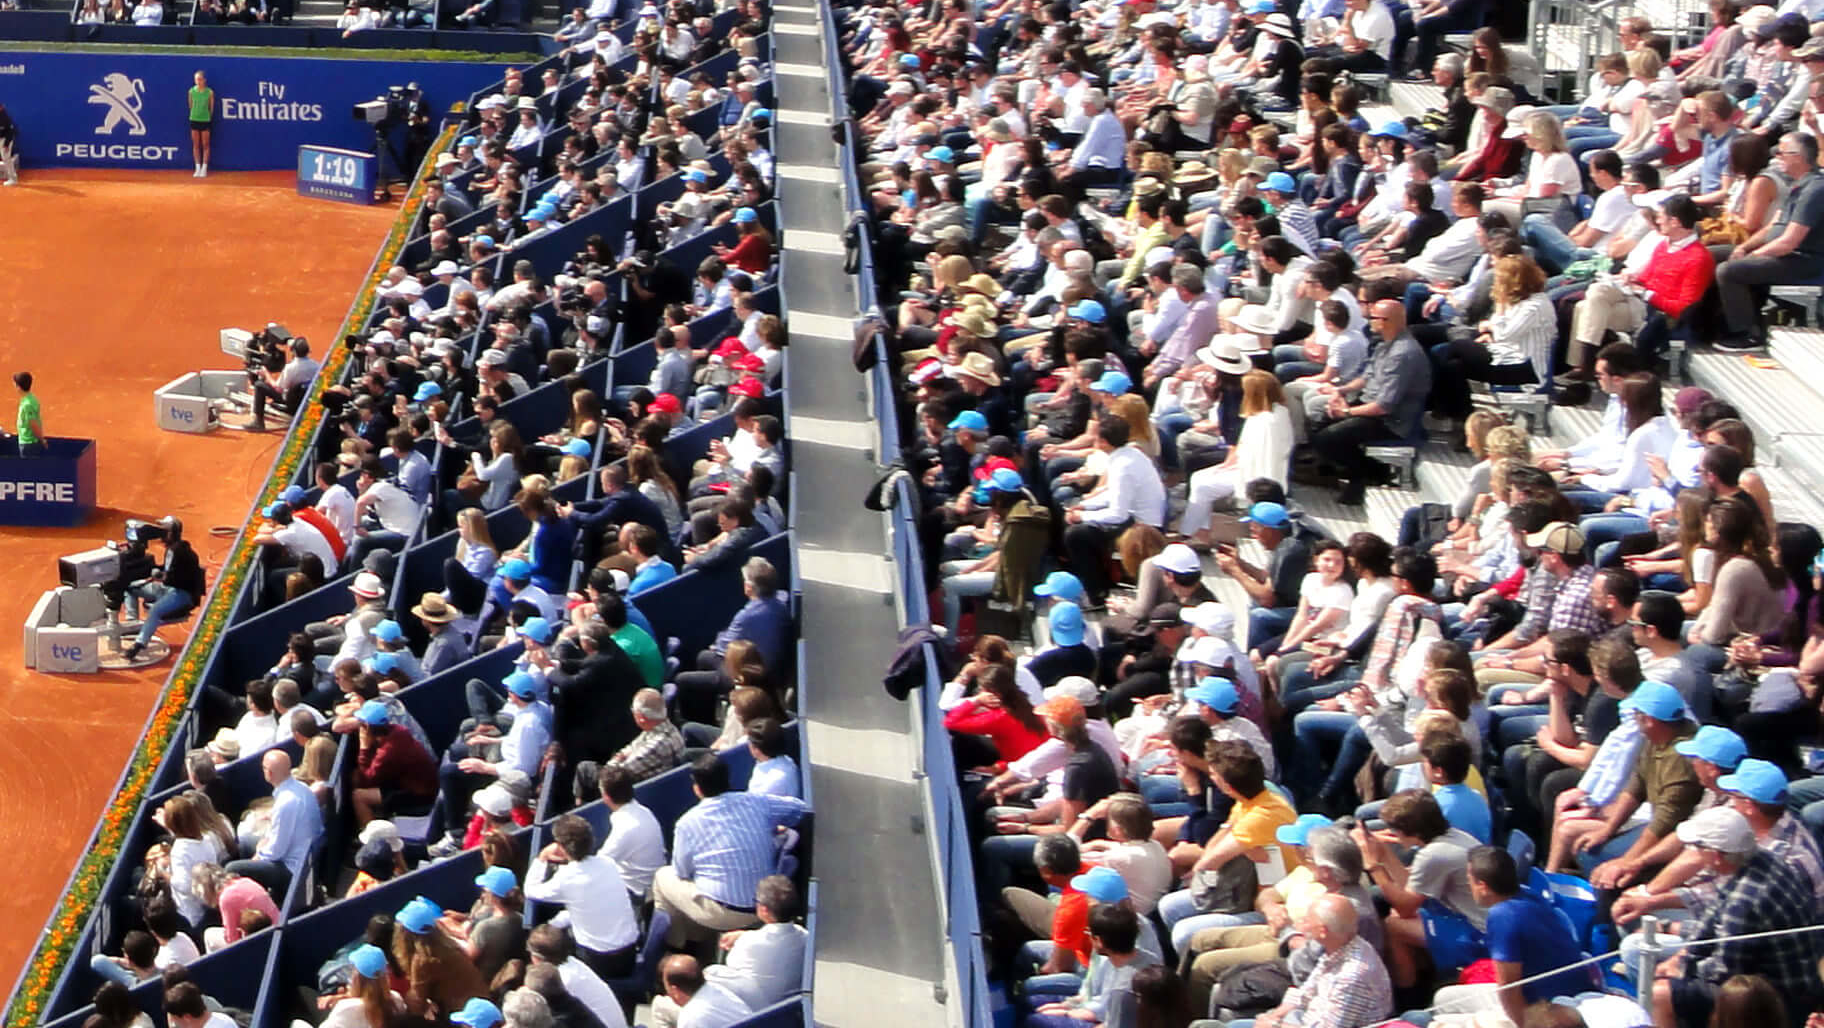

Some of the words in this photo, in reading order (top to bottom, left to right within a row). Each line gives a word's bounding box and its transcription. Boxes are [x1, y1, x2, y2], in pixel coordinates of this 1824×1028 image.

[258, 81, 286, 100] Fly
[222, 97, 323, 121] Emirates
[56, 144, 179, 161] PEUGEOT
[312, 153, 356, 186] 1:19
[170, 405, 193, 423] tve
[52, 641, 83, 663] tve
